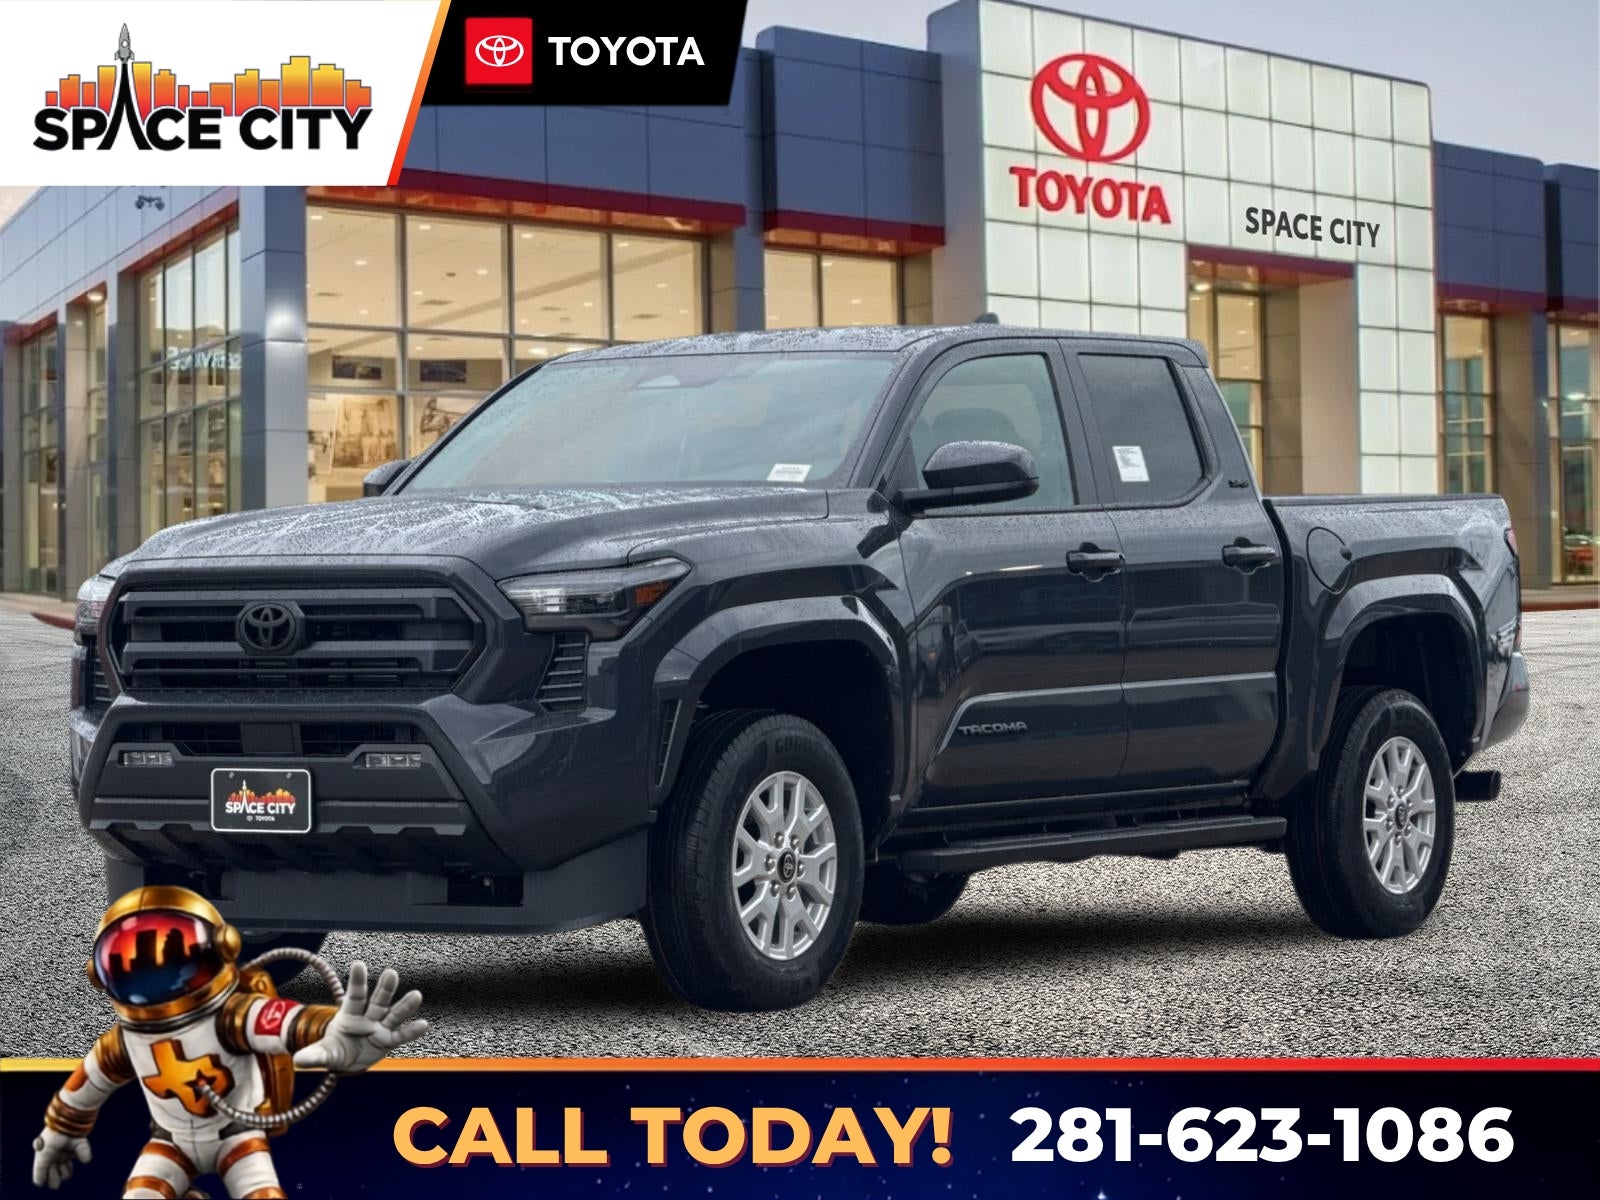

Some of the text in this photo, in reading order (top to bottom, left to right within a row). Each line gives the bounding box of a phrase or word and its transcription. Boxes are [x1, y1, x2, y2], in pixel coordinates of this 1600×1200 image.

[1009, 166, 1171, 225] TOYOTA
[1245, 206, 1381, 249] SPACE CITY
[957, 721, 1028, 735] TACOMA
[225, 799, 296, 815] SPACE CITY
